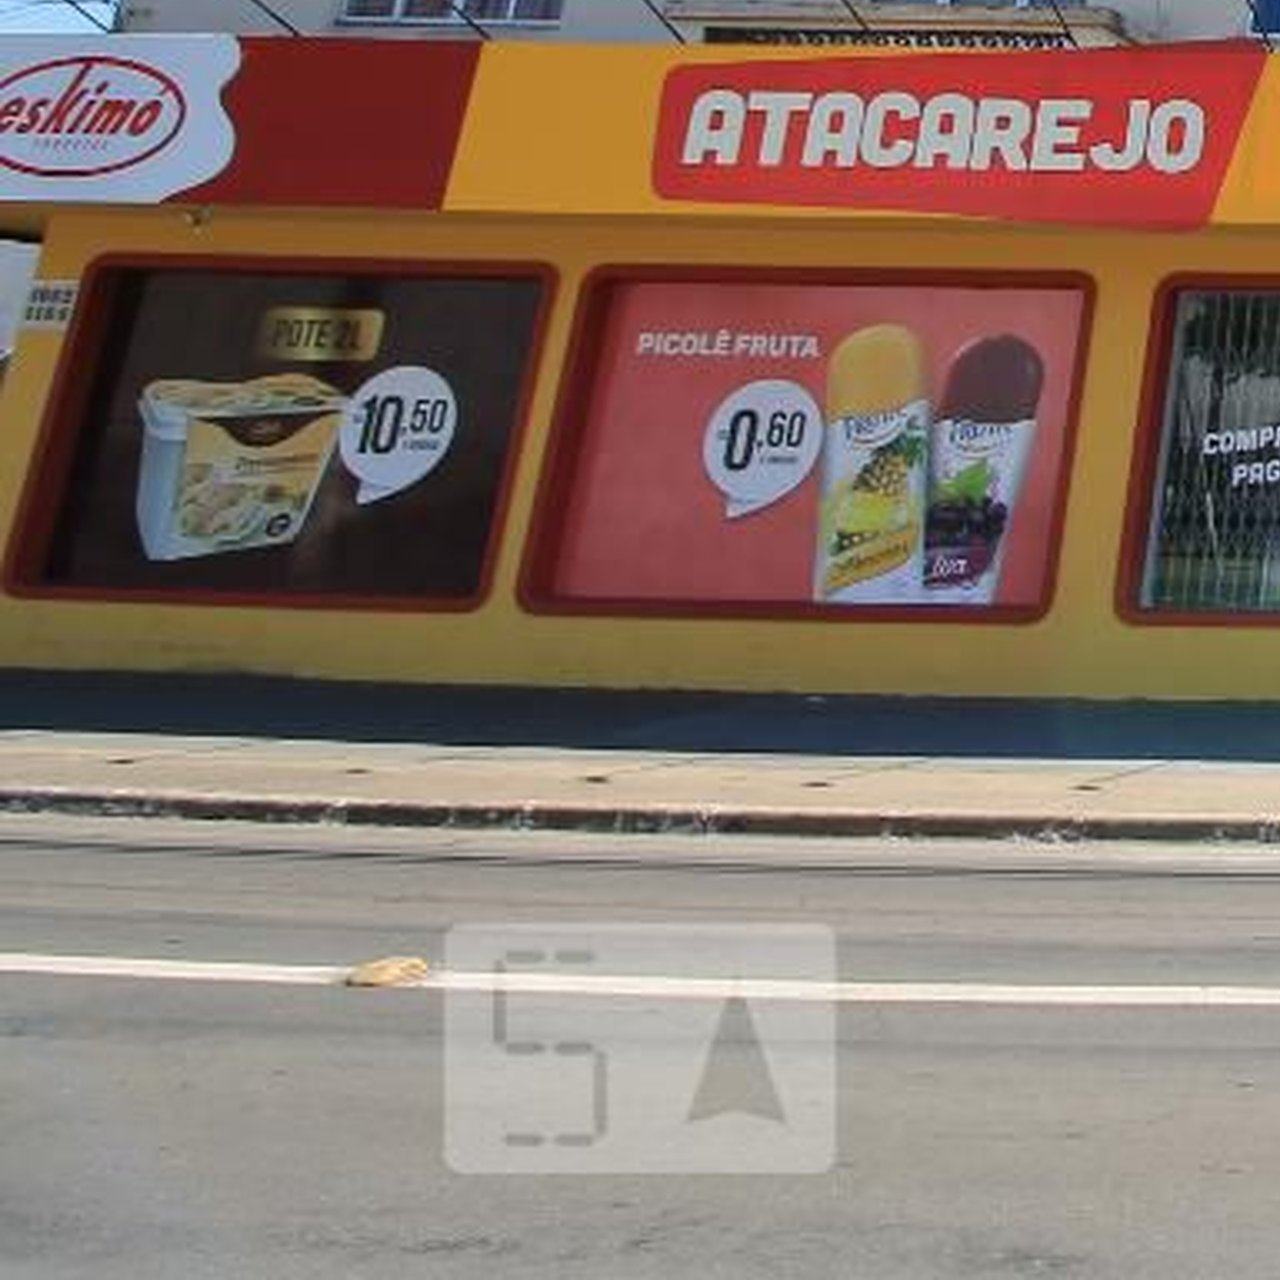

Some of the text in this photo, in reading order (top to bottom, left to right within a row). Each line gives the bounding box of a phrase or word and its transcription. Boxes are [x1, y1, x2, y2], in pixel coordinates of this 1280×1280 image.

[682, 89, 1205, 173] ATACAREJO
[271, 319, 332, 349] POTE
[732, 334, 821, 359] FRUTA
